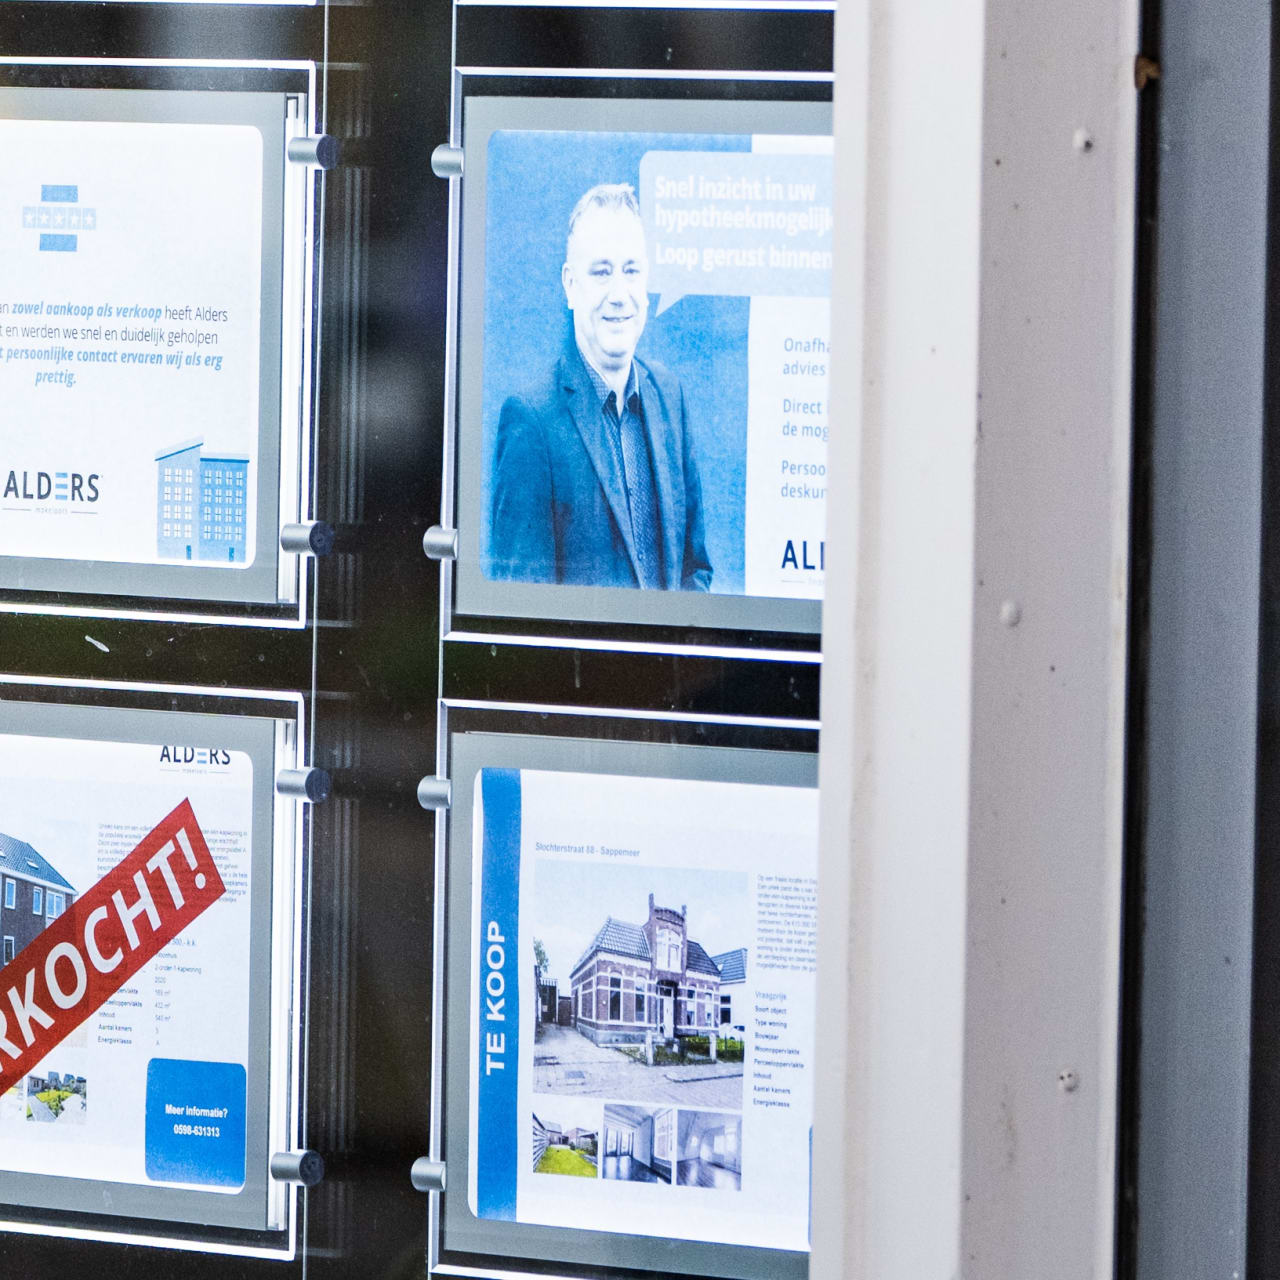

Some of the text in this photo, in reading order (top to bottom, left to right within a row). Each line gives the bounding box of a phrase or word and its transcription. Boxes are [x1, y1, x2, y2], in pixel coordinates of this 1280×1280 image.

[655, 175, 817, 201] Snel inzicht in uw
[655, 242, 699, 272] Loop
[701, 245, 766, 273] gerust
[11, 300, 44, 315] zowel
[46, 301, 94, 320] aankoop
[96, 302, 113, 317] als
[116, 304, 162, 323] verkoop
[165, 305, 192, 321] heeft
[194, 306, 228, 322] Alders
[5, 325, 19, 337] en
[21, 323, 61, 339] werden
[63, 327, 78, 340] we
[80, 325, 102, 340] snel
[104, 329, 118, 341] en
[120, 326, 165, 346] duidelijk
[168, 328, 218, 348] geholpen
[6, 346, 74, 365] persoonlijke
[76, 349, 118, 363] contact
[120, 351, 163, 365] ervaren
[165, 351, 183, 369] wij
[185, 351, 201, 366] als
[204, 354, 223, 371] erg
[783, 360, 826, 376] advies
[34, 368, 77, 387] prettig.
[783, 398, 822, 415] Direct
[782, 420, 797, 436] de
[3, 470, 100, 503] ALDERS
[159, 745, 231, 766] ALDERS
[600, 846, 641, 857] Sappemeer
[485, 920, 506, 1076] TE KOOP
[165, 1103, 228, 1119] Meer informatie?
[173, 1123, 220, 1138] 0598-631313
